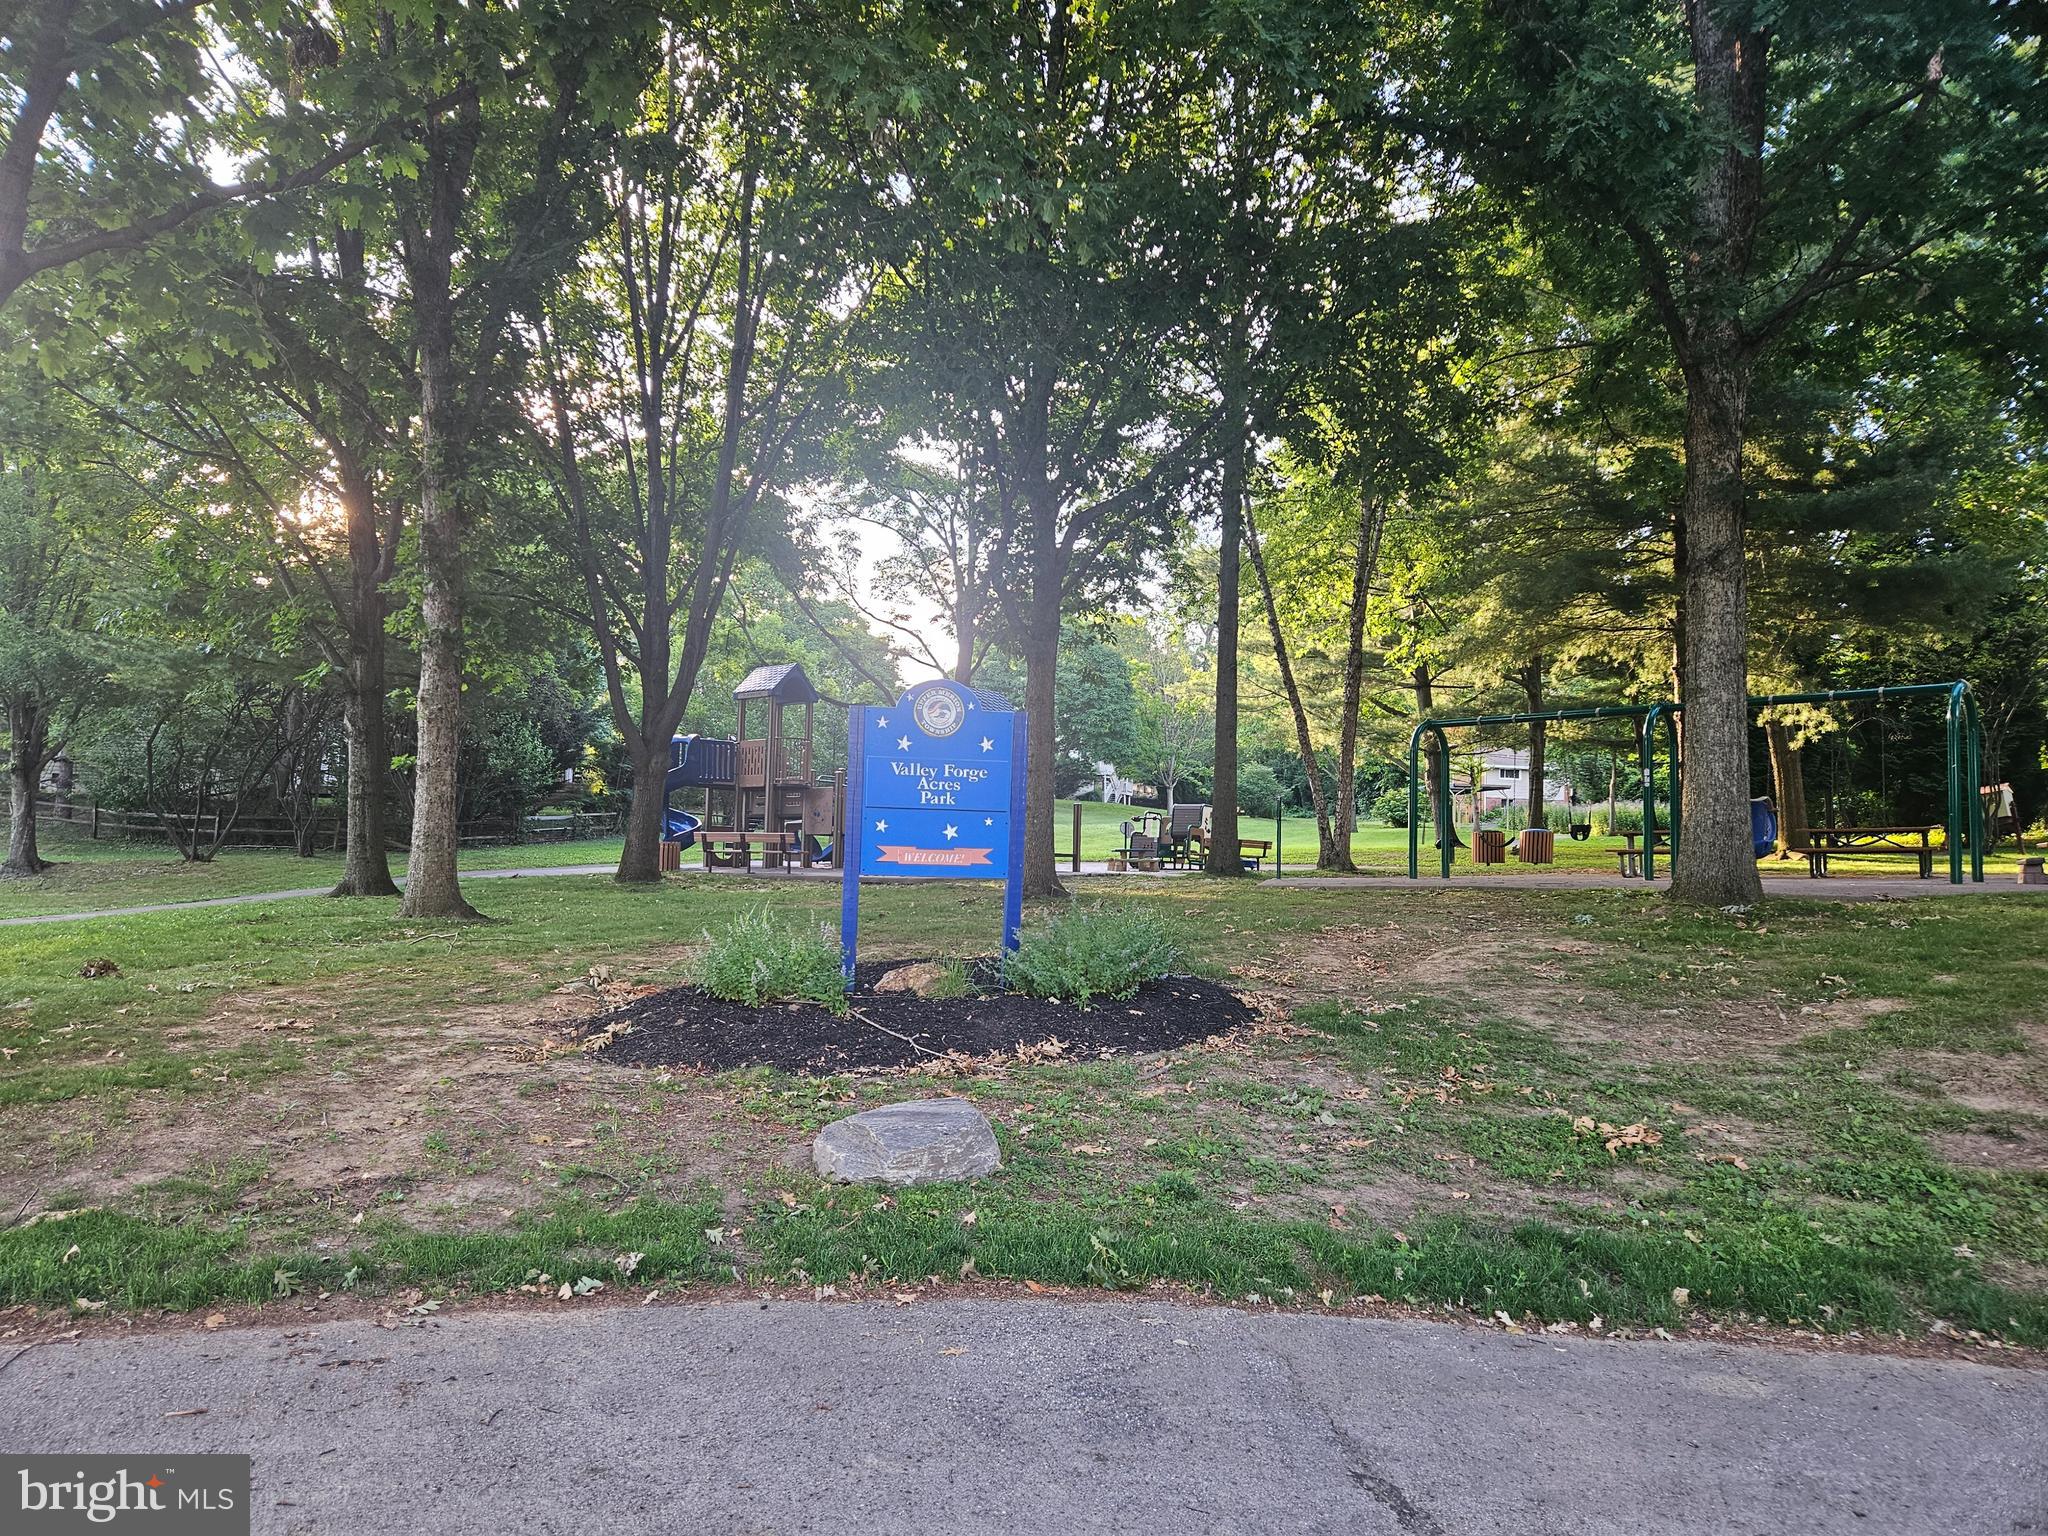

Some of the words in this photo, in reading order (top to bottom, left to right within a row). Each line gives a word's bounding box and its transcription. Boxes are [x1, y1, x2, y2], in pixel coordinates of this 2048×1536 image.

[917, 690, 937, 710] UPPER
[890, 762, 938, 781] Valley
[944, 764, 988, 782] Forge
[917, 778, 961, 790] Acres
[920, 791, 956, 805] Park
[904, 852, 965, 864] WELCOME!
